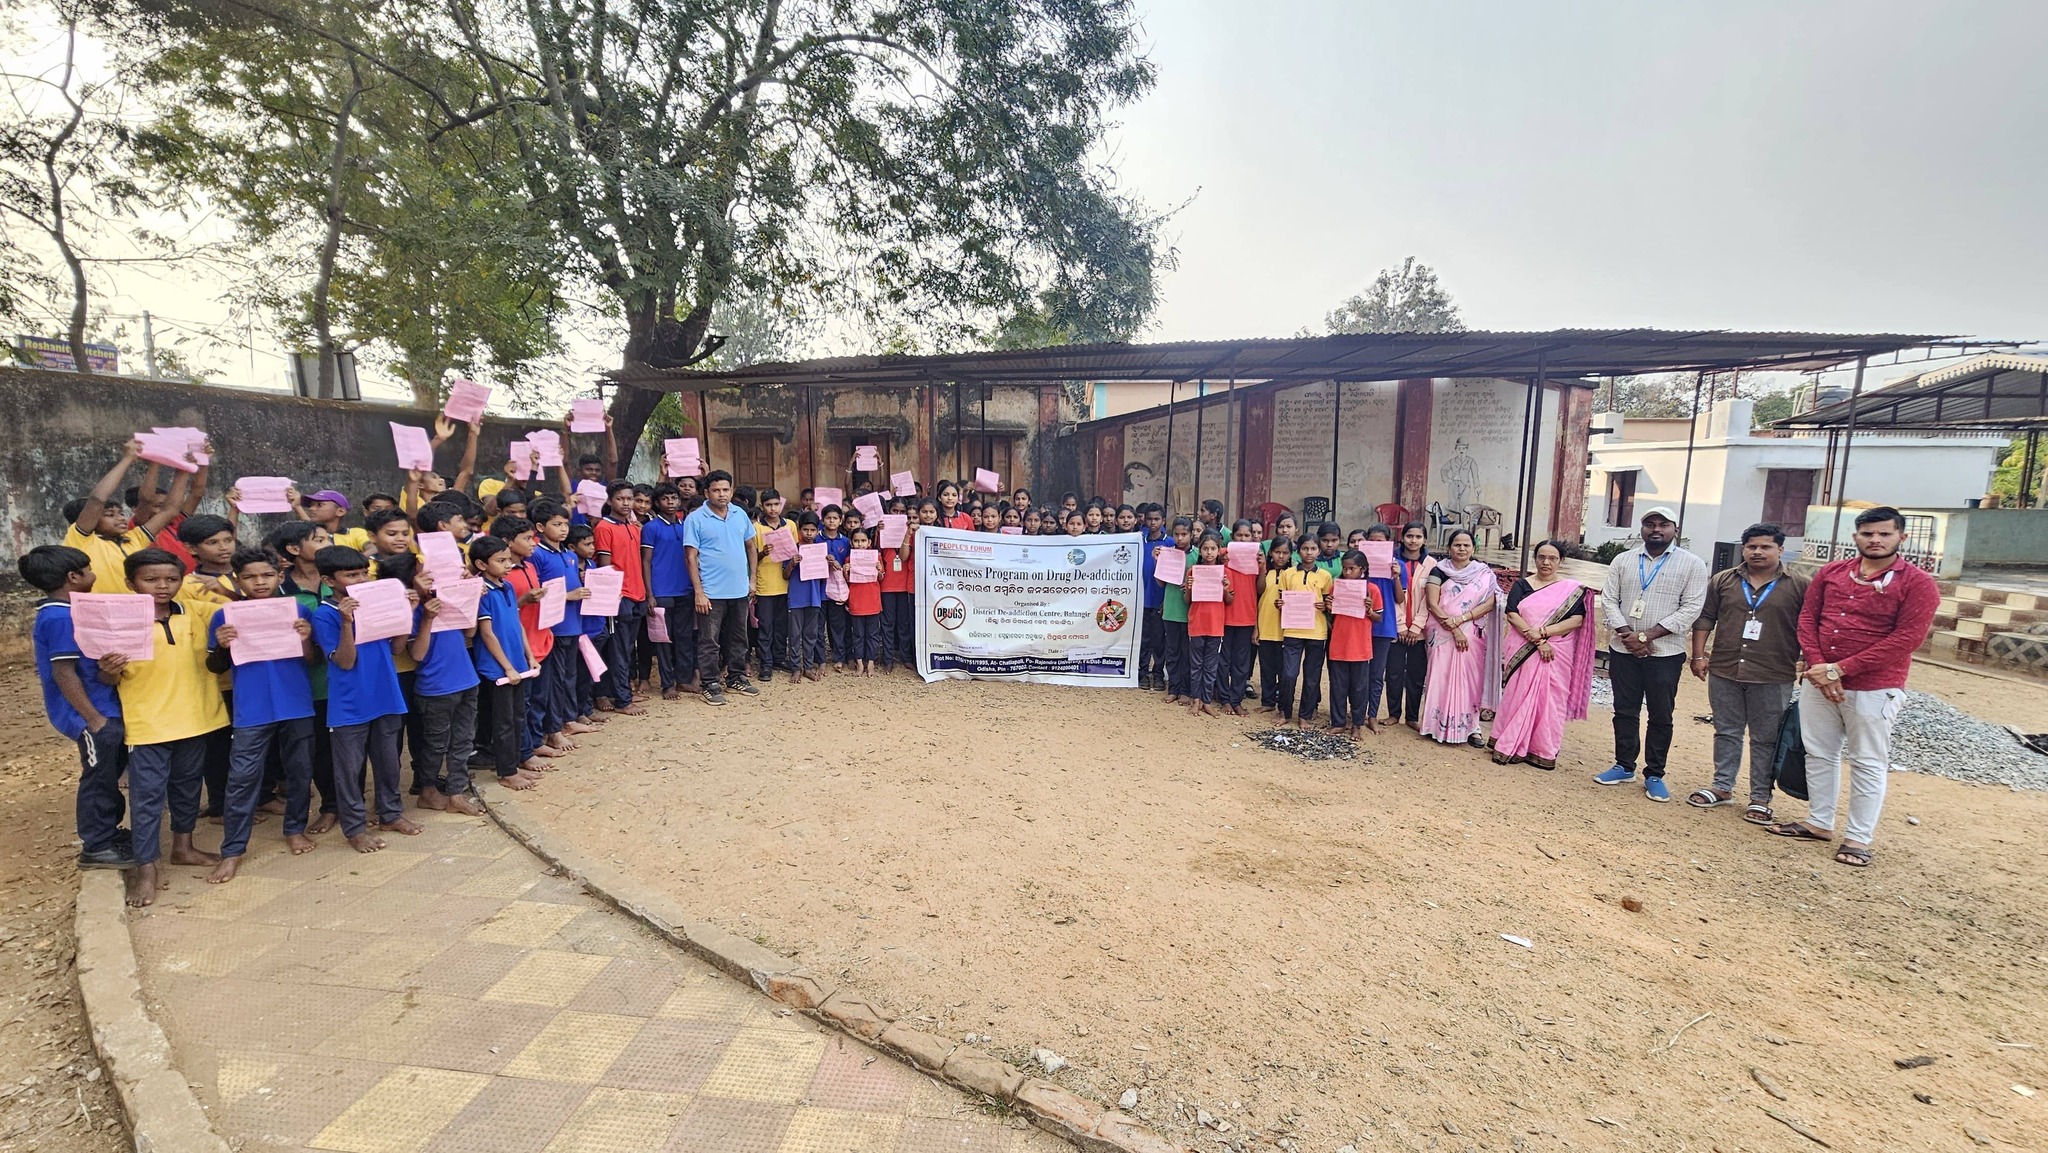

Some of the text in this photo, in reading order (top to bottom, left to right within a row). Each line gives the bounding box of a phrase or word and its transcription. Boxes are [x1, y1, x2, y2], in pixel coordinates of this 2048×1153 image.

[939, 542, 969, 551] PEOPLE'S
[930, 564, 1133, 584] Awareness Program on Drug De-addiction
[936, 607, 963, 619] DRUGS
[972, 608, 996, 616] District
[997, 608, 1038, 617] De-addiction
[1039, 610, 1062, 618] Centre,
